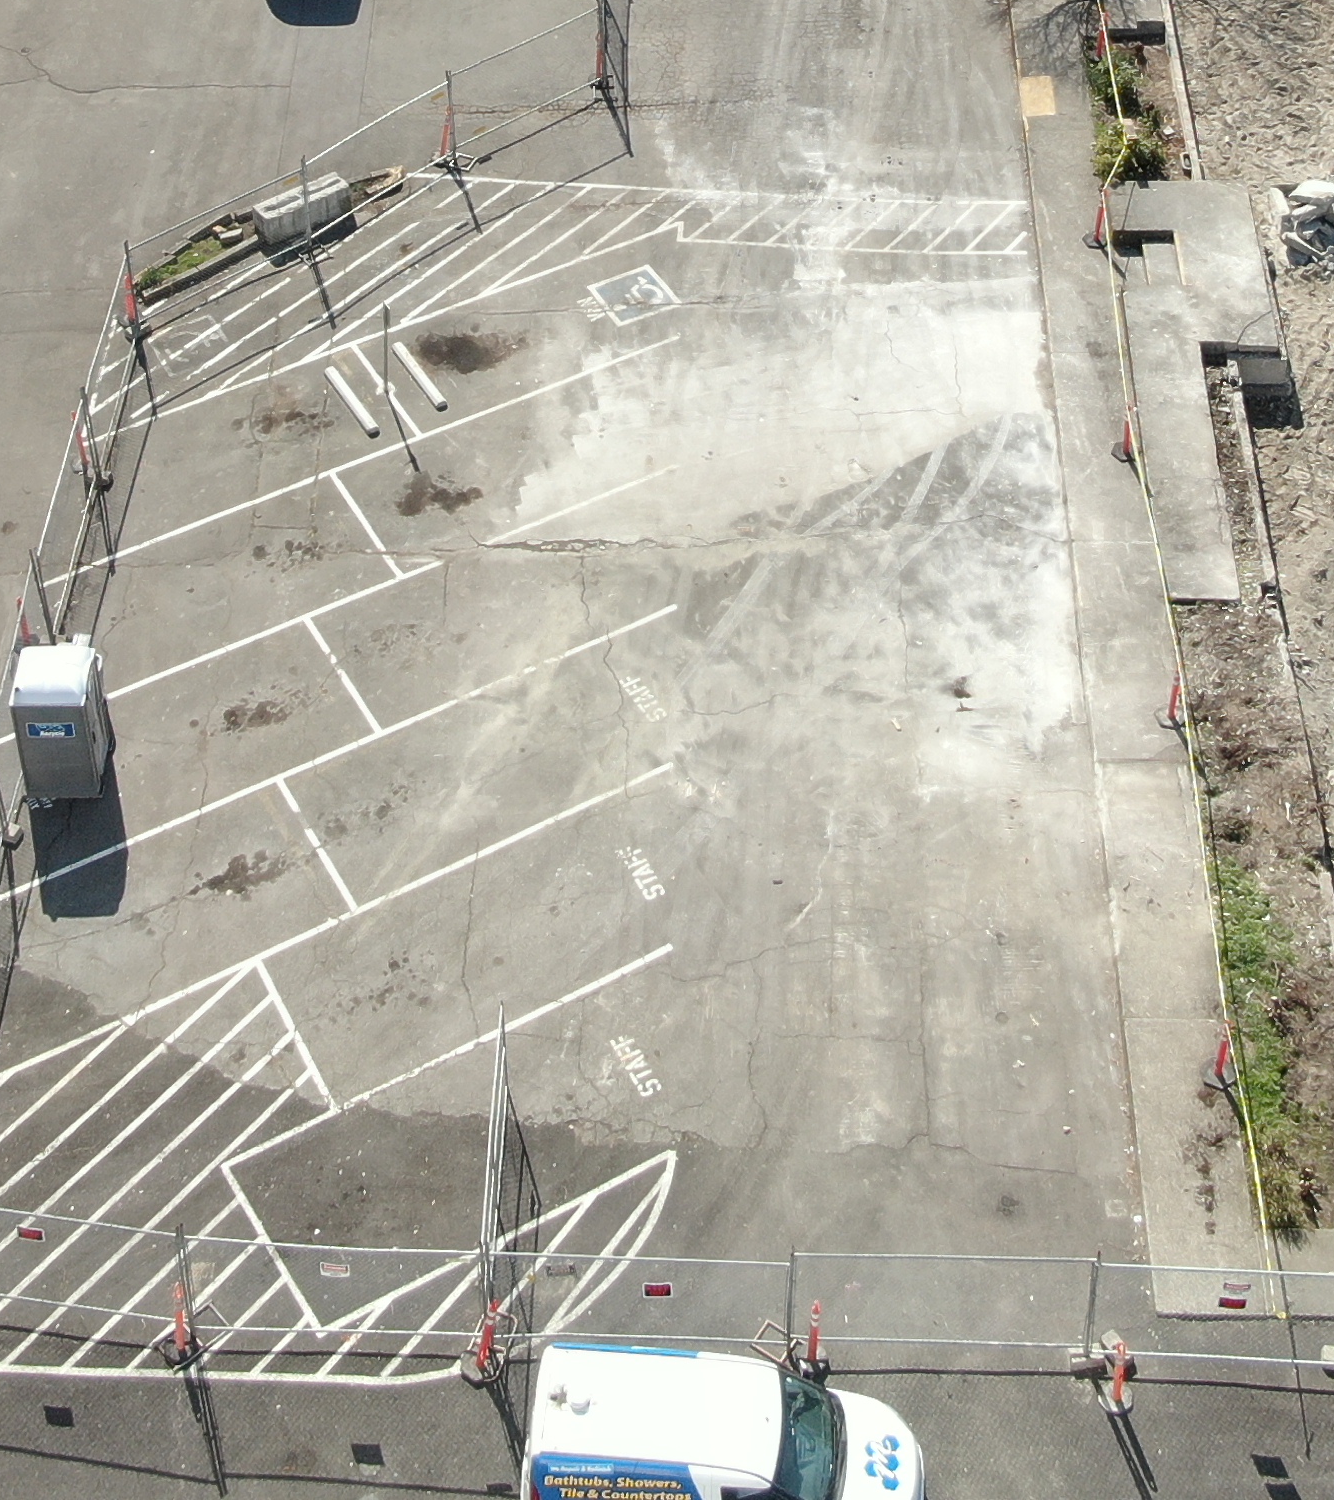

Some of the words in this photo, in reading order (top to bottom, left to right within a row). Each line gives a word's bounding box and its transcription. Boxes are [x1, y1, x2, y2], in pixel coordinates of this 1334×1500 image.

[618, 676, 668, 723] STAFF
[609, 1035, 662, 1097] STAFF
[544, 1475, 613, 1488] Bathtubs,
[617, 1476, 682, 1490] Showers,
[559, 1487, 584, 1499] Tile
[587, 1489, 600, 1499] &
